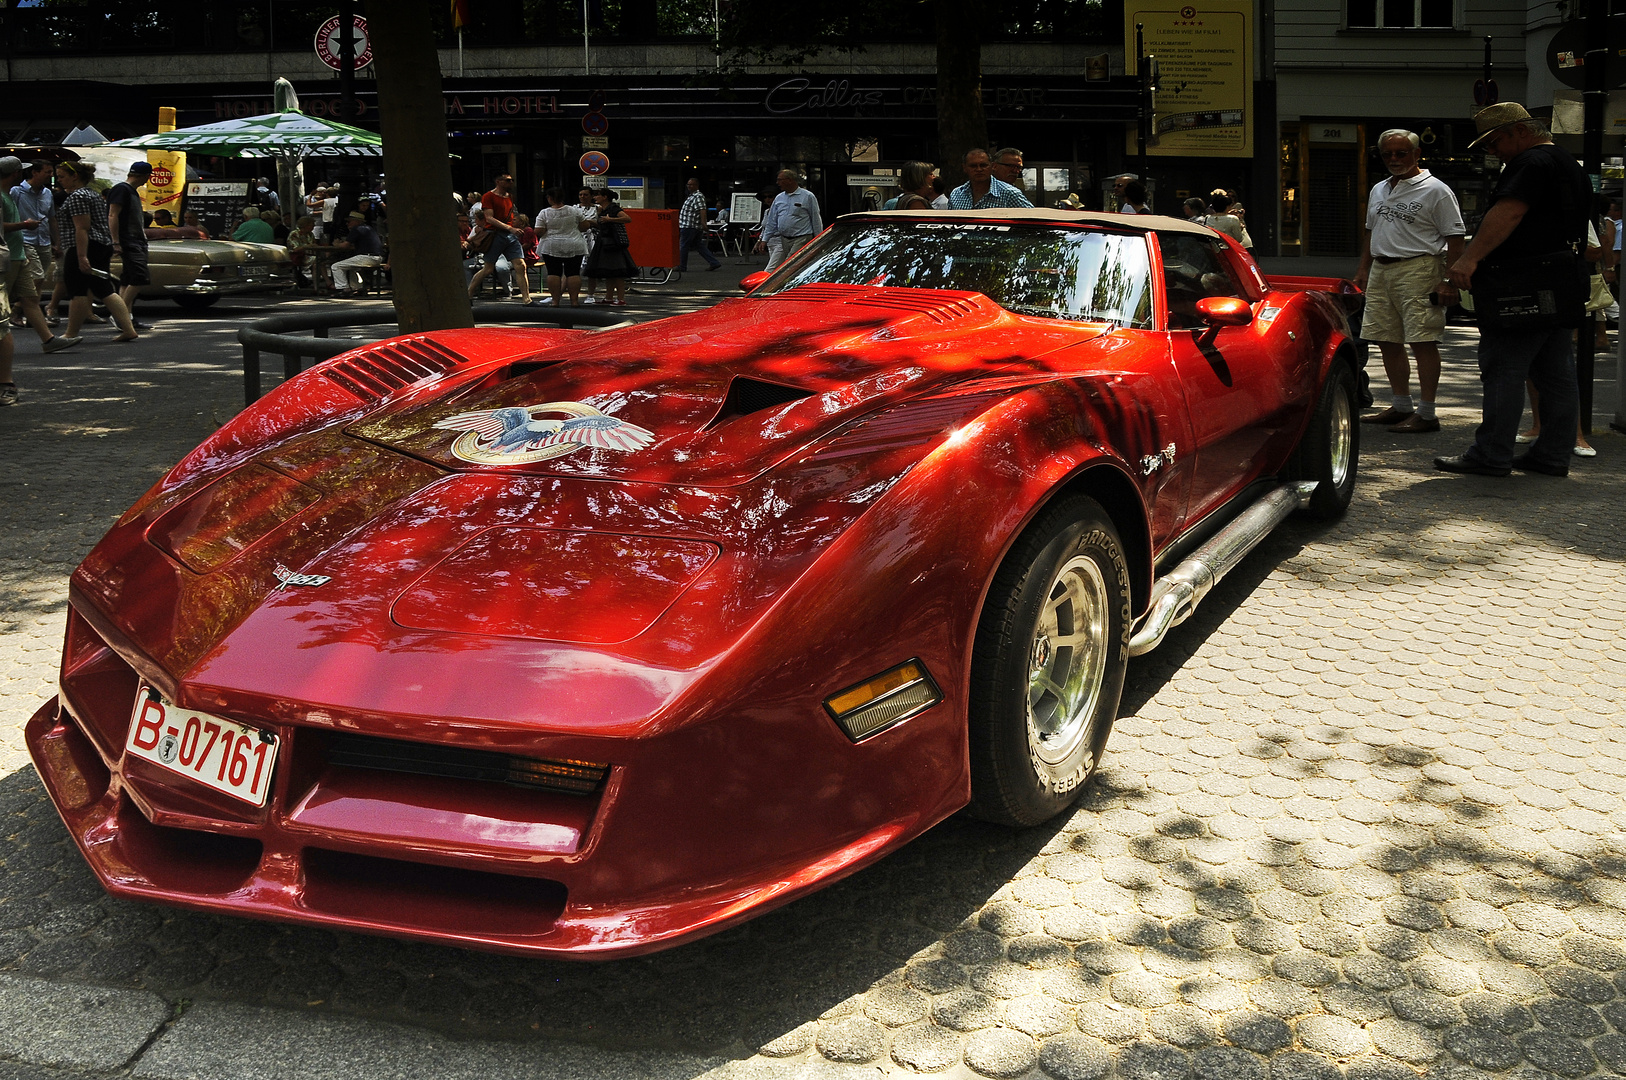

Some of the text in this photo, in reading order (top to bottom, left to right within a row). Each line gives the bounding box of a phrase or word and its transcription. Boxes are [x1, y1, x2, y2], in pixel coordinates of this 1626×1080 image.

[318, 18, 341, 62] BERLINER
[483, 95, 565, 115] HOTEL
[764, 77, 885, 115] Callas
[995, 86, 1047, 105] BAR
[1323, 128, 1342, 138] 201
[150, 176, 169, 184] Club
[657, 213, 672, 221] 519
[915, 223, 1012, 232] CORVETTE
[1076, 529, 1130, 662] BRIDGESTONE
[133, 698, 268, 795] B-07161
